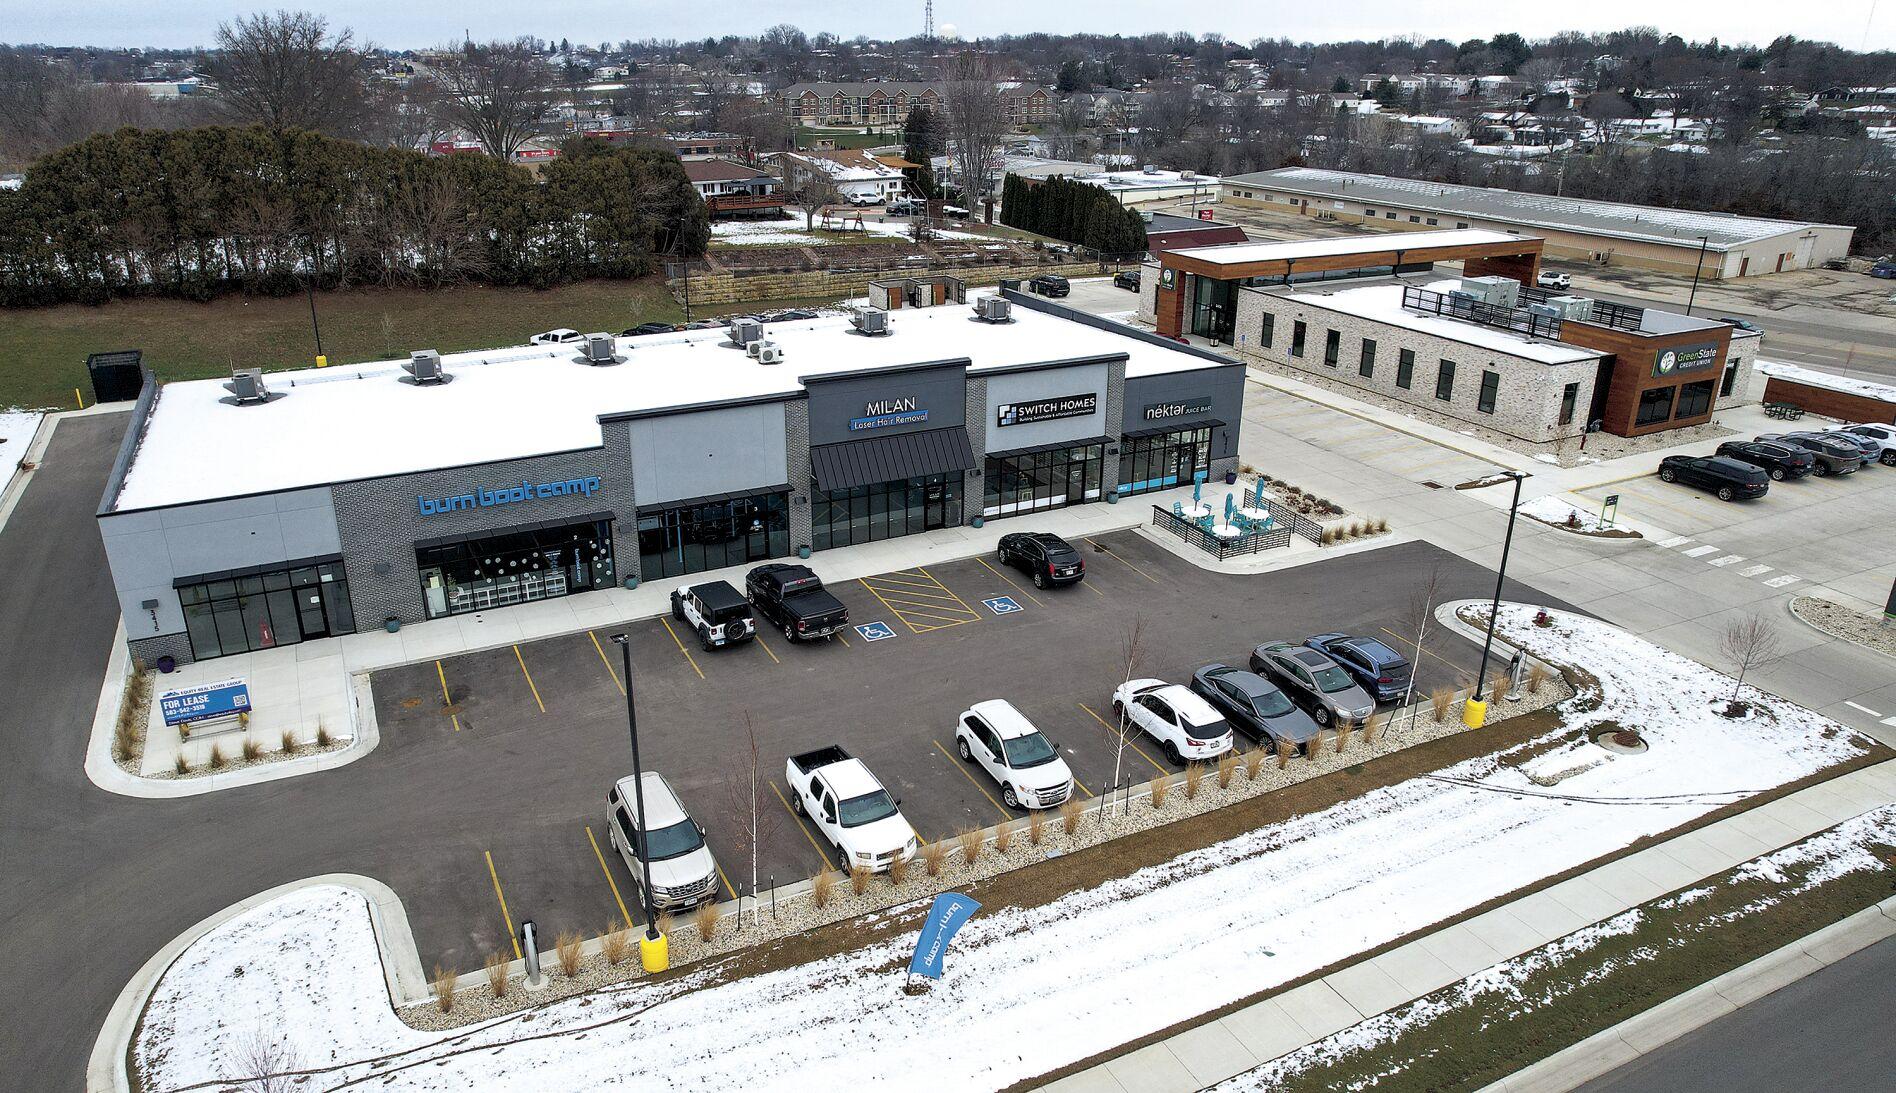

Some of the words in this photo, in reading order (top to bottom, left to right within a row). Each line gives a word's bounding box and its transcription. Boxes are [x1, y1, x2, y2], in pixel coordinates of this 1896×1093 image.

[1677, 348, 1717, 362] GreenState
[1680, 360, 1697, 369] CREDIT
[1697, 358, 1711, 366] UNION
[866, 397, 916, 416] MILAN
[1018, 402, 1057, 416] SWITCH
[1060, 397, 1095, 411] HOMES
[1186, 406, 1200, 415] JUICE
[854, 421, 875, 430] Laser
[877, 418, 893, 427] Hair
[895, 412, 928, 424] Removal
[418, 494, 476, 516] burn
[478, 480, 534, 507] boot
[537, 476, 600, 497] camp
[163, 700, 180, 710] FOR
[182, 695, 210, 708] LEASE
[941, 902, 963, 924] burn
[924, 941, 941, 967] camp
